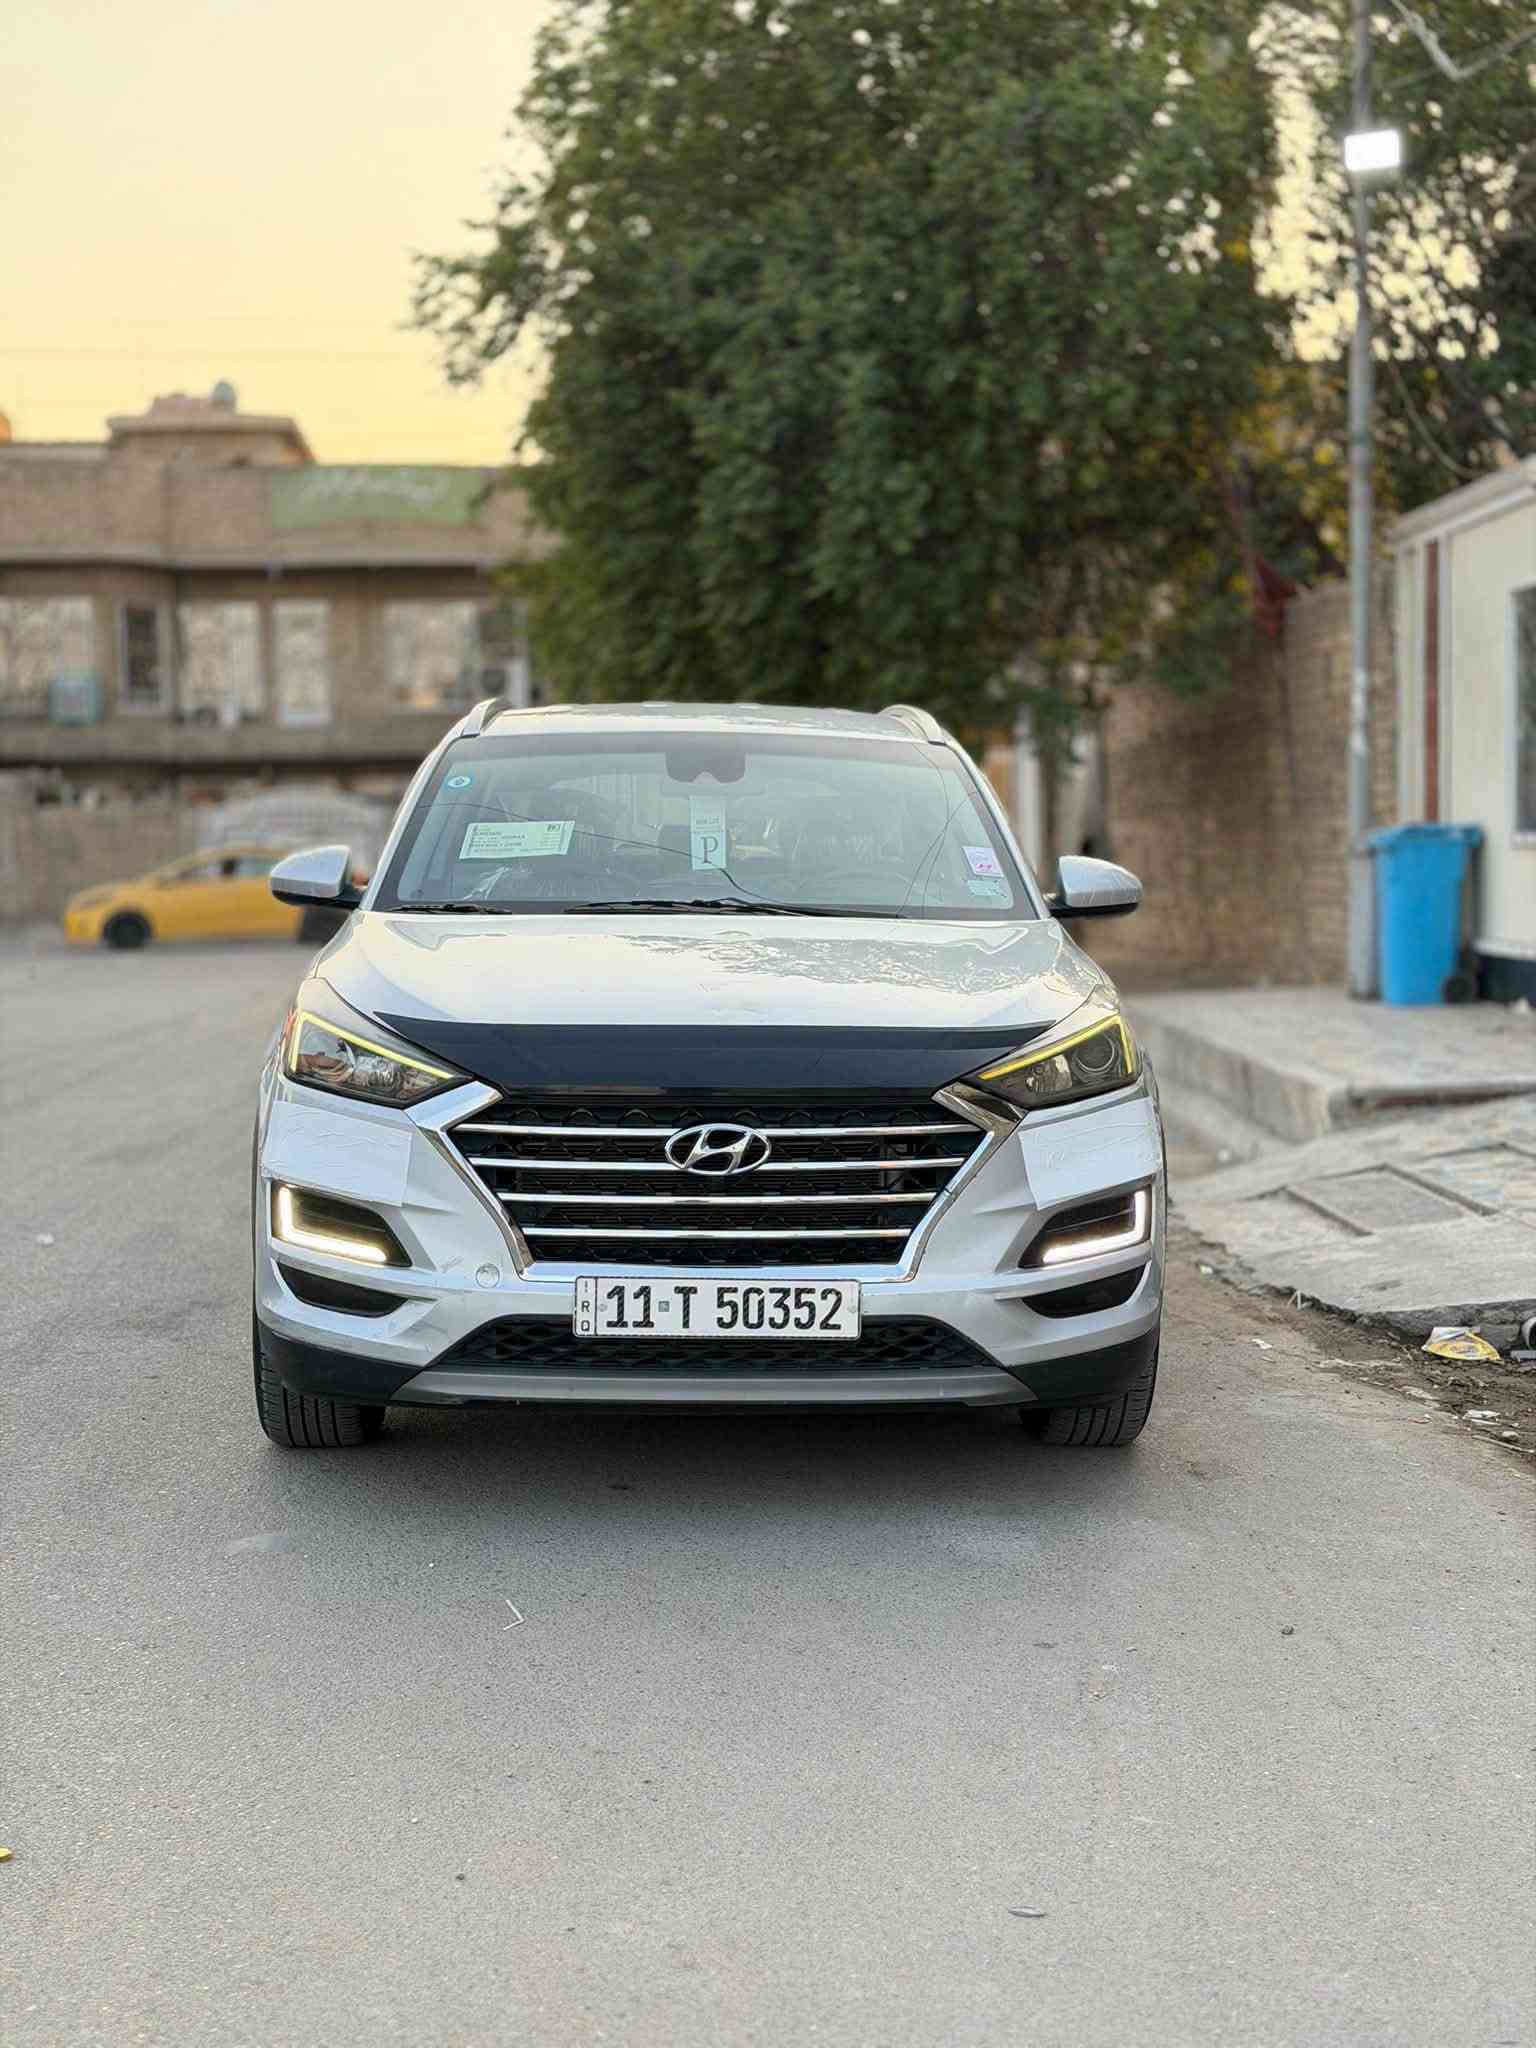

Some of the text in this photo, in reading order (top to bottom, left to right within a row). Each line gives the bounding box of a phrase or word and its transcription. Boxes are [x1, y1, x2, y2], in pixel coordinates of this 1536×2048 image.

[700, 836, 718, 864] P
[606, 1285, 843, 1330] 11 T 50352
